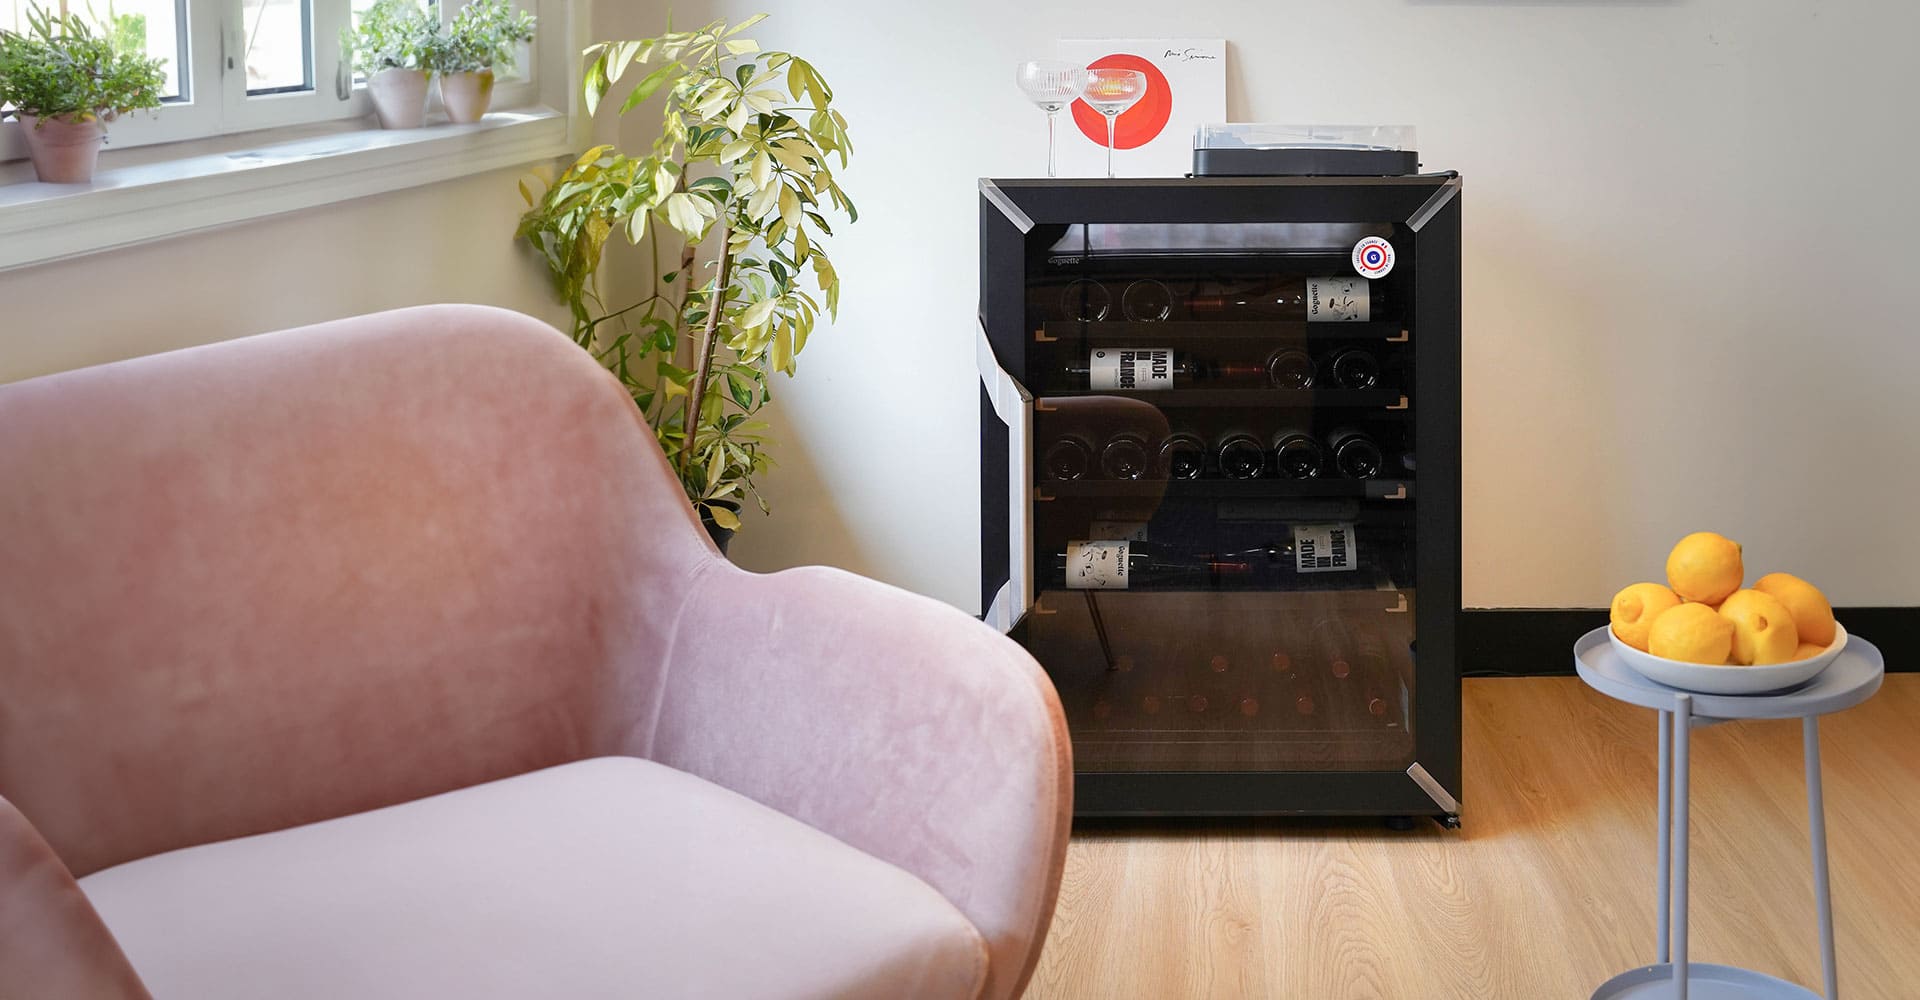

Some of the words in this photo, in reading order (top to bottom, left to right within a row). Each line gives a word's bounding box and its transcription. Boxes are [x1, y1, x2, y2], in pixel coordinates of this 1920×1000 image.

[1311, 283, 1320, 315] Goguette
[1120, 351, 1135, 389] FRANCE
[1152, 352, 1168, 379] MADE
[1116, 545, 1126, 577] Goguette
[1300, 539, 1315, 568] MADE
[1330, 529, 1347, 567] FRANCE
